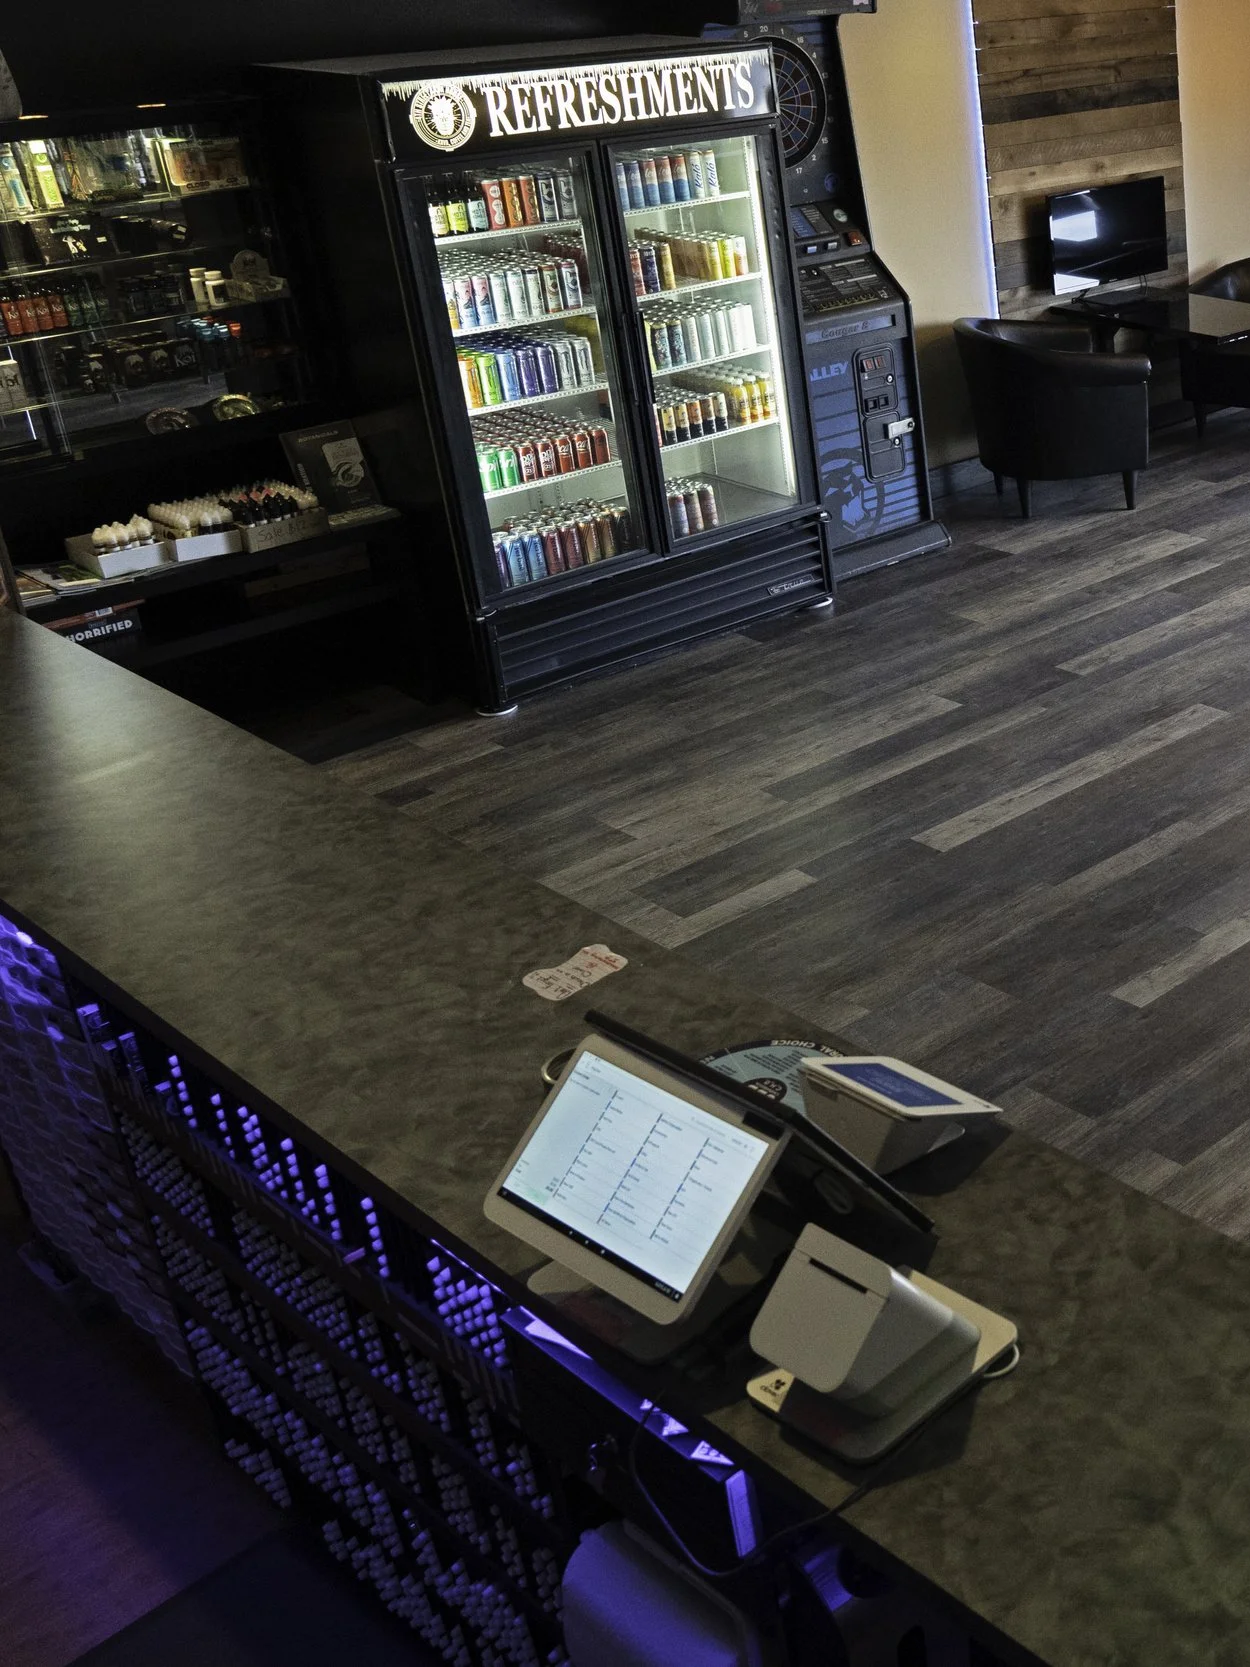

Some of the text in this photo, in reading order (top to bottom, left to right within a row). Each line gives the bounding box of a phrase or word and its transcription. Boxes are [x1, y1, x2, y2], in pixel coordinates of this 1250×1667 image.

[812, 51, 817, 59] 4
[481, 61, 754, 137] REFRESHMENTS
[65, 619, 134, 644] HORRIFIED
[770, 1039, 816, 1049] CHOICE
